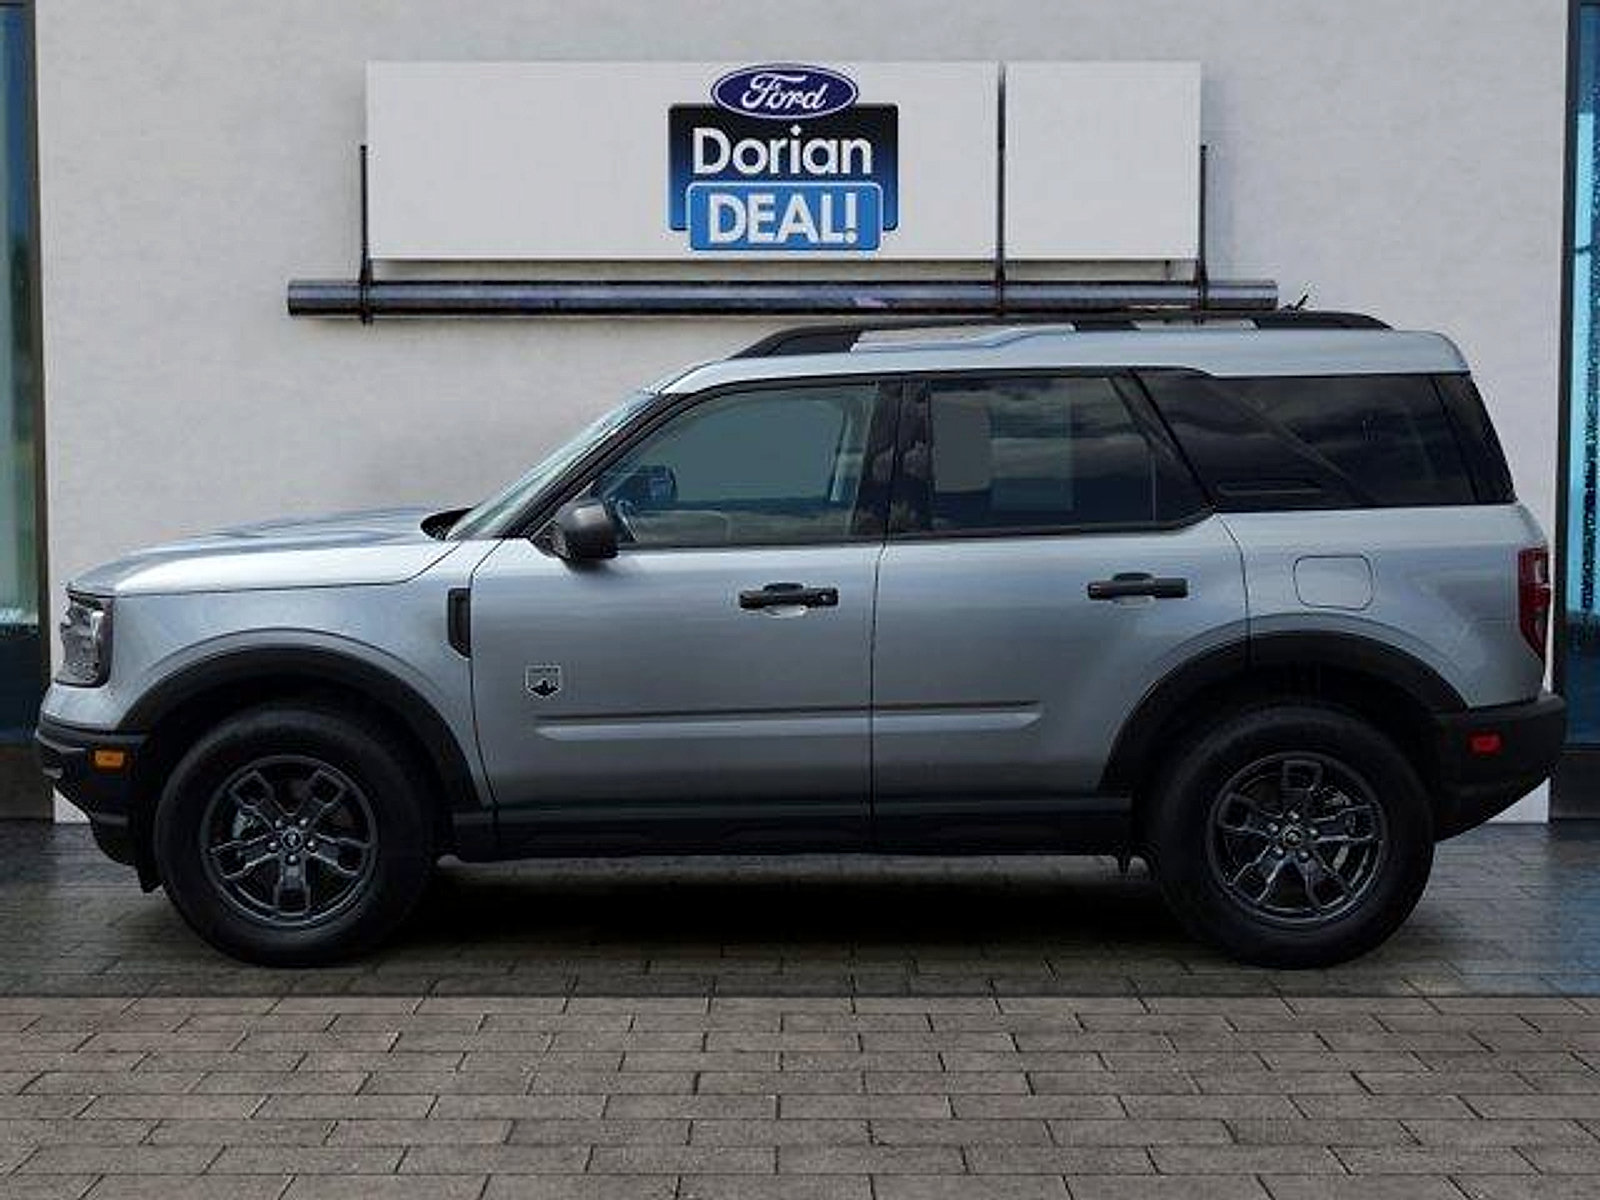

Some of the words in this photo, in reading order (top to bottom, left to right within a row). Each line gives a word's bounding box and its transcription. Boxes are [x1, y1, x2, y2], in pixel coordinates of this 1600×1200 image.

[741, 73, 829, 109] Ford
[692, 125, 872, 174] Dorian
[709, 192, 858, 244] DEAL!
